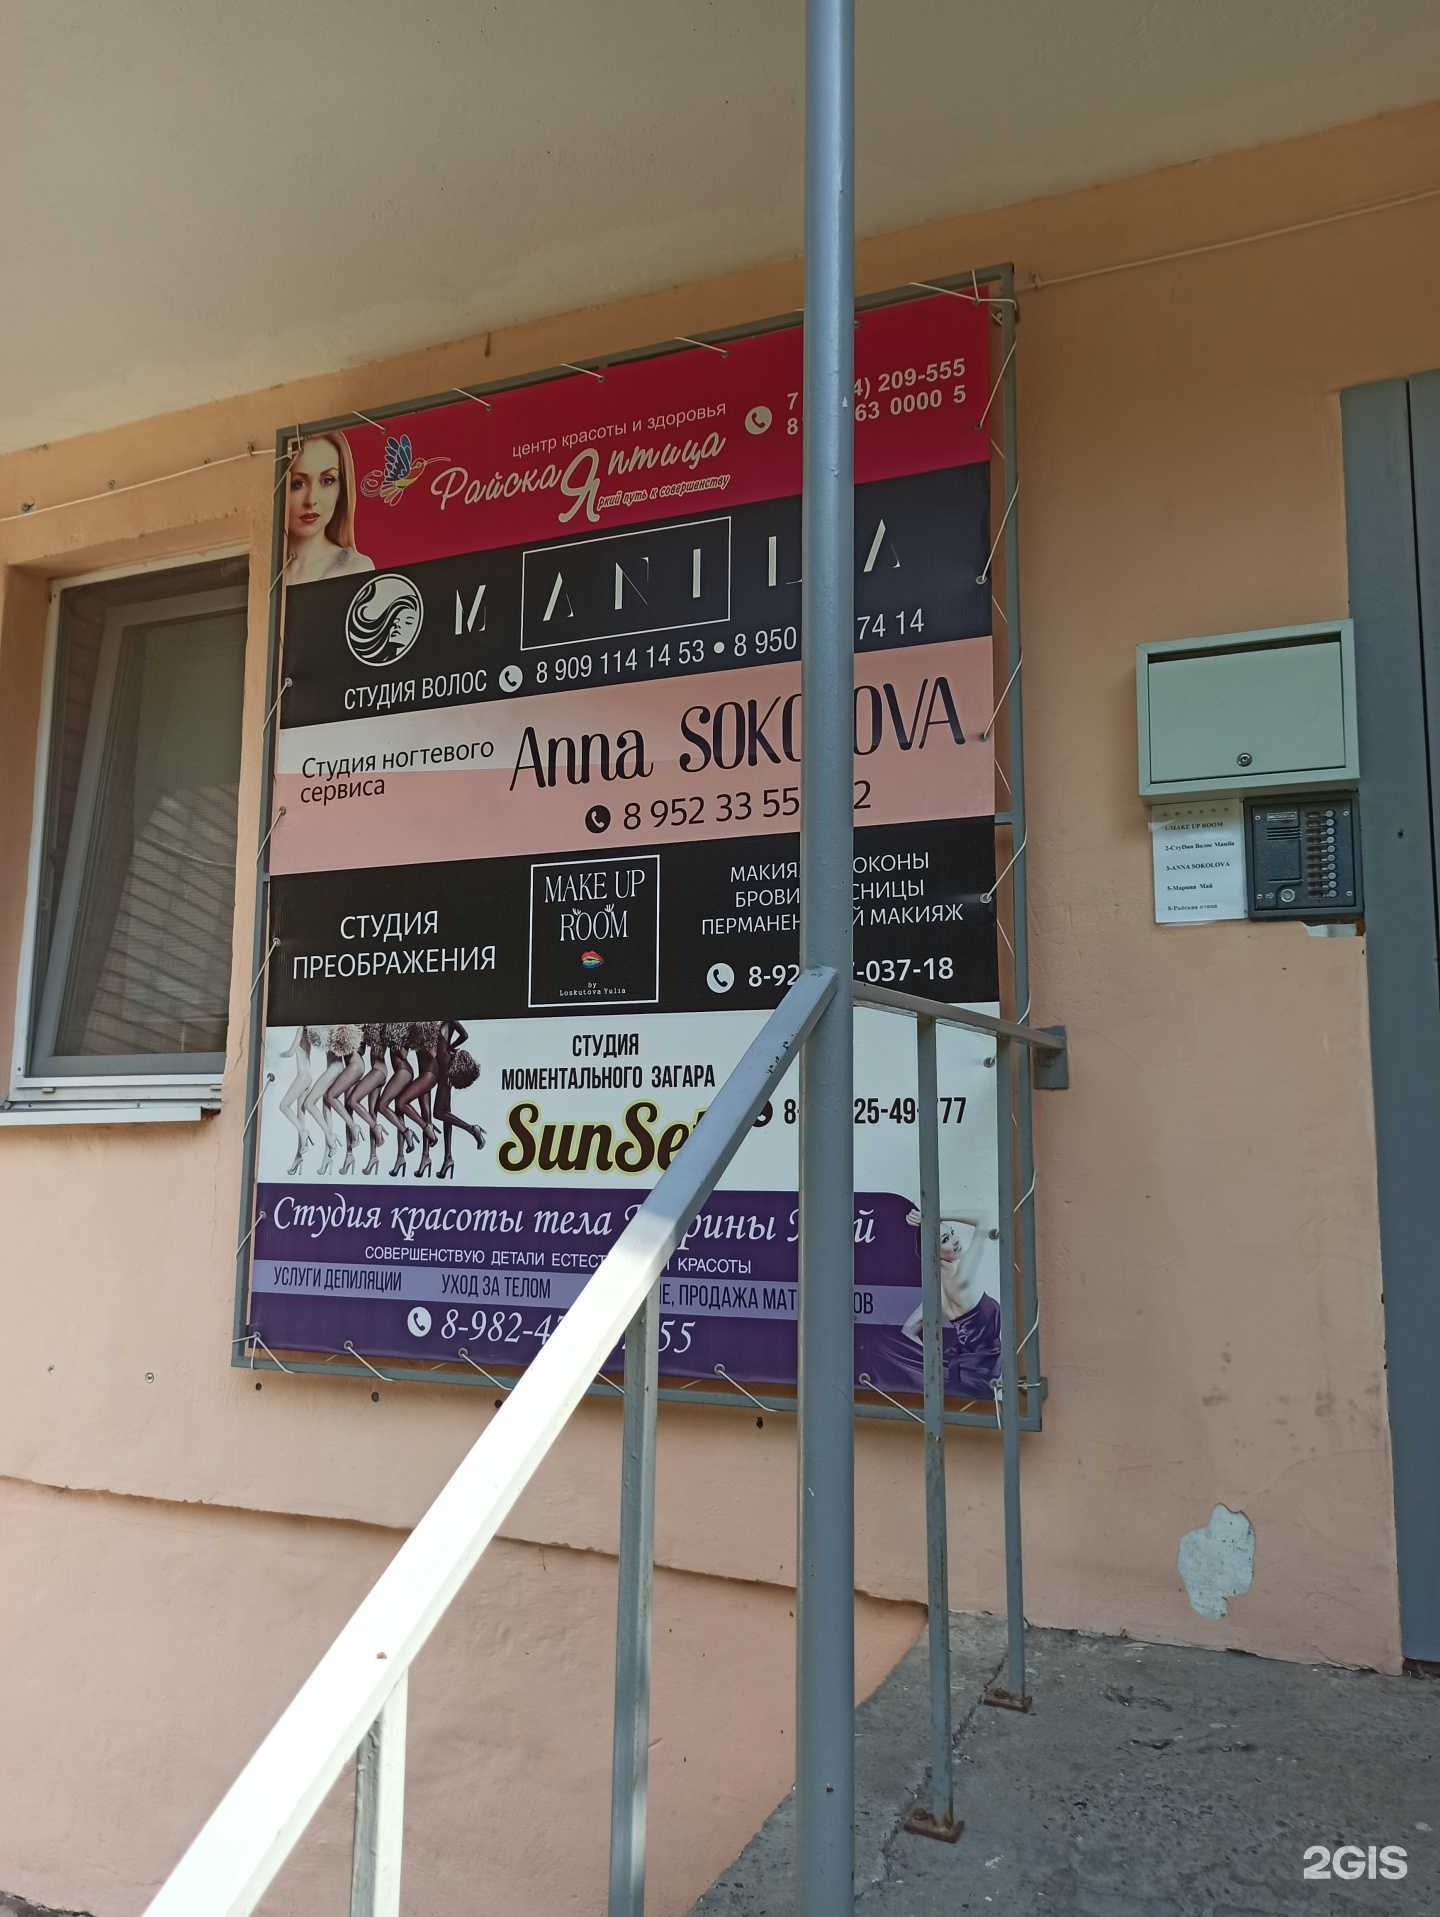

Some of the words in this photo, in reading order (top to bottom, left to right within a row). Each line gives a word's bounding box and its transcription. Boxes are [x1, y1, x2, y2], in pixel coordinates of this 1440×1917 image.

[878, 357, 966, 393] 209-555
[787, 417, 798, 435] 8
[890, 389, 942, 415] 0000
[953, 384, 966, 403] 5
[512, 437, 557, 458] центр
[562, 420, 627, 447] красоты
[632, 420, 642, 433] и
[647, 403, 726, 429] здоровья
[608, 431, 726, 476] птица
[622, 490, 647, 506] путь
[650, 488, 658, 500] к
[659, 475, 730, 498] совершенству
[345, 680, 415, 710] СТУДИЯ
[422, 669, 487, 701] ВОЛОС
[536, 661, 548, 684] 8
[555, 655, 592, 681] 909
[600, 648, 637, 675] 114
[646, 643, 670, 668] 14
[678, 639, 705, 664] 53
[734, 633, 746, 657] 8
[755, 626, 797, 653] 950
[896, 608, 924, 635] 14
[509, 726, 653, 791] Anna
[679, 676, 965, 773] SOKOOVA
[301, 752, 376, 782] Студия
[382, 740, 494, 770] ногтевого
[300, 777, 385, 806] сервиса
[623, 801, 642, 830] 8
[650, 796, 705, 828] 952
[715, 792, 752, 822] 33
[730, 861, 800, 883] МАКИЯ
[852, 851, 929, 873] ОКОНЫ
[544, 872, 608, 903] MAKE
[615, 869, 646, 898] UP
[735, 886, 800, 908] БРОВИ
[852, 879, 924, 901] СНИЦЫ
[340, 910, 439, 942] СТУДИЯ
[560, 908, 629, 941] ROOM
[870, 903, 964, 926] МАКИЯЖ
[292, 945, 496, 980] ПРЕОБРАЖЕНИЯ
[572, 1033, 639, 1058] СТУДИЯ
[501, 1066, 643, 1091] МОМЕНТАЛЬНОГО
[651, 1064, 715, 1088] ЗАГАРА
[499, 1101, 706, 1173] SunSe
[273, 1192, 381, 1238] Студия
[391, 1205, 523, 1241] красоты
[534, 1210, 612, 1236] тела
[365, 1246, 485, 1264] СОВЕРШЕНСТВУЮ
[491, 1251, 545, 1267] ДЕТАЛИ
[678, 1257, 752, 1275] КРАСОТЫ
[274, 1266, 321, 1290] УСЛУГИ
[324, 1269, 402, 1293] ДЕПИЛЯЦИИ
[441, 1274, 480, 1297] УХОД
[482, 1276, 500, 1297] ЗА
[504, 1277, 551, 1299] ТЕЛОМ
[679, 1284, 758, 1311] ПРОДАЖА
